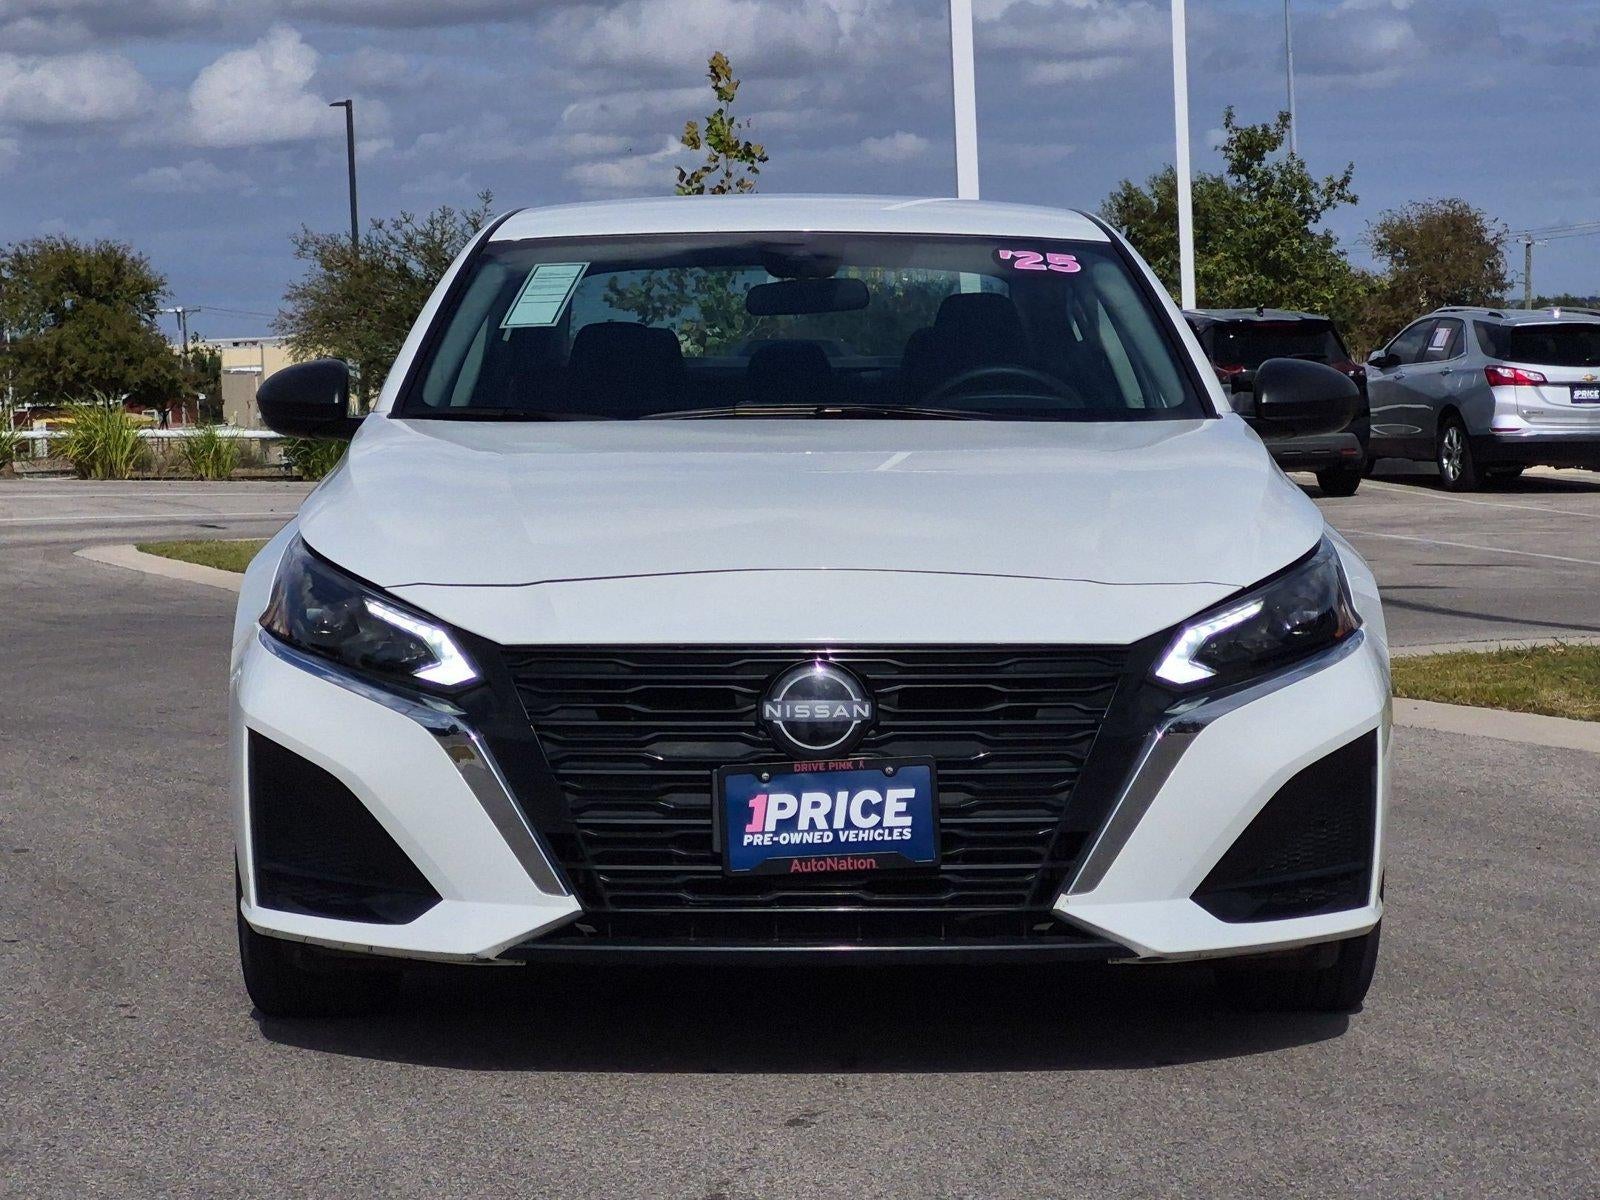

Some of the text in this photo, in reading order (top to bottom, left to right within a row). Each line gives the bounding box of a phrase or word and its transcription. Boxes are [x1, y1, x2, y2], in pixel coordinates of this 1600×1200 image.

[999, 249, 1082, 273] '25
[765, 704, 870, 718] NISSAN
[793, 761, 853, 772] DRIVE PINK
[743, 828, 912, 846] PRE-OWNED VEHICLES
[790, 857, 878, 873] AutoNation
